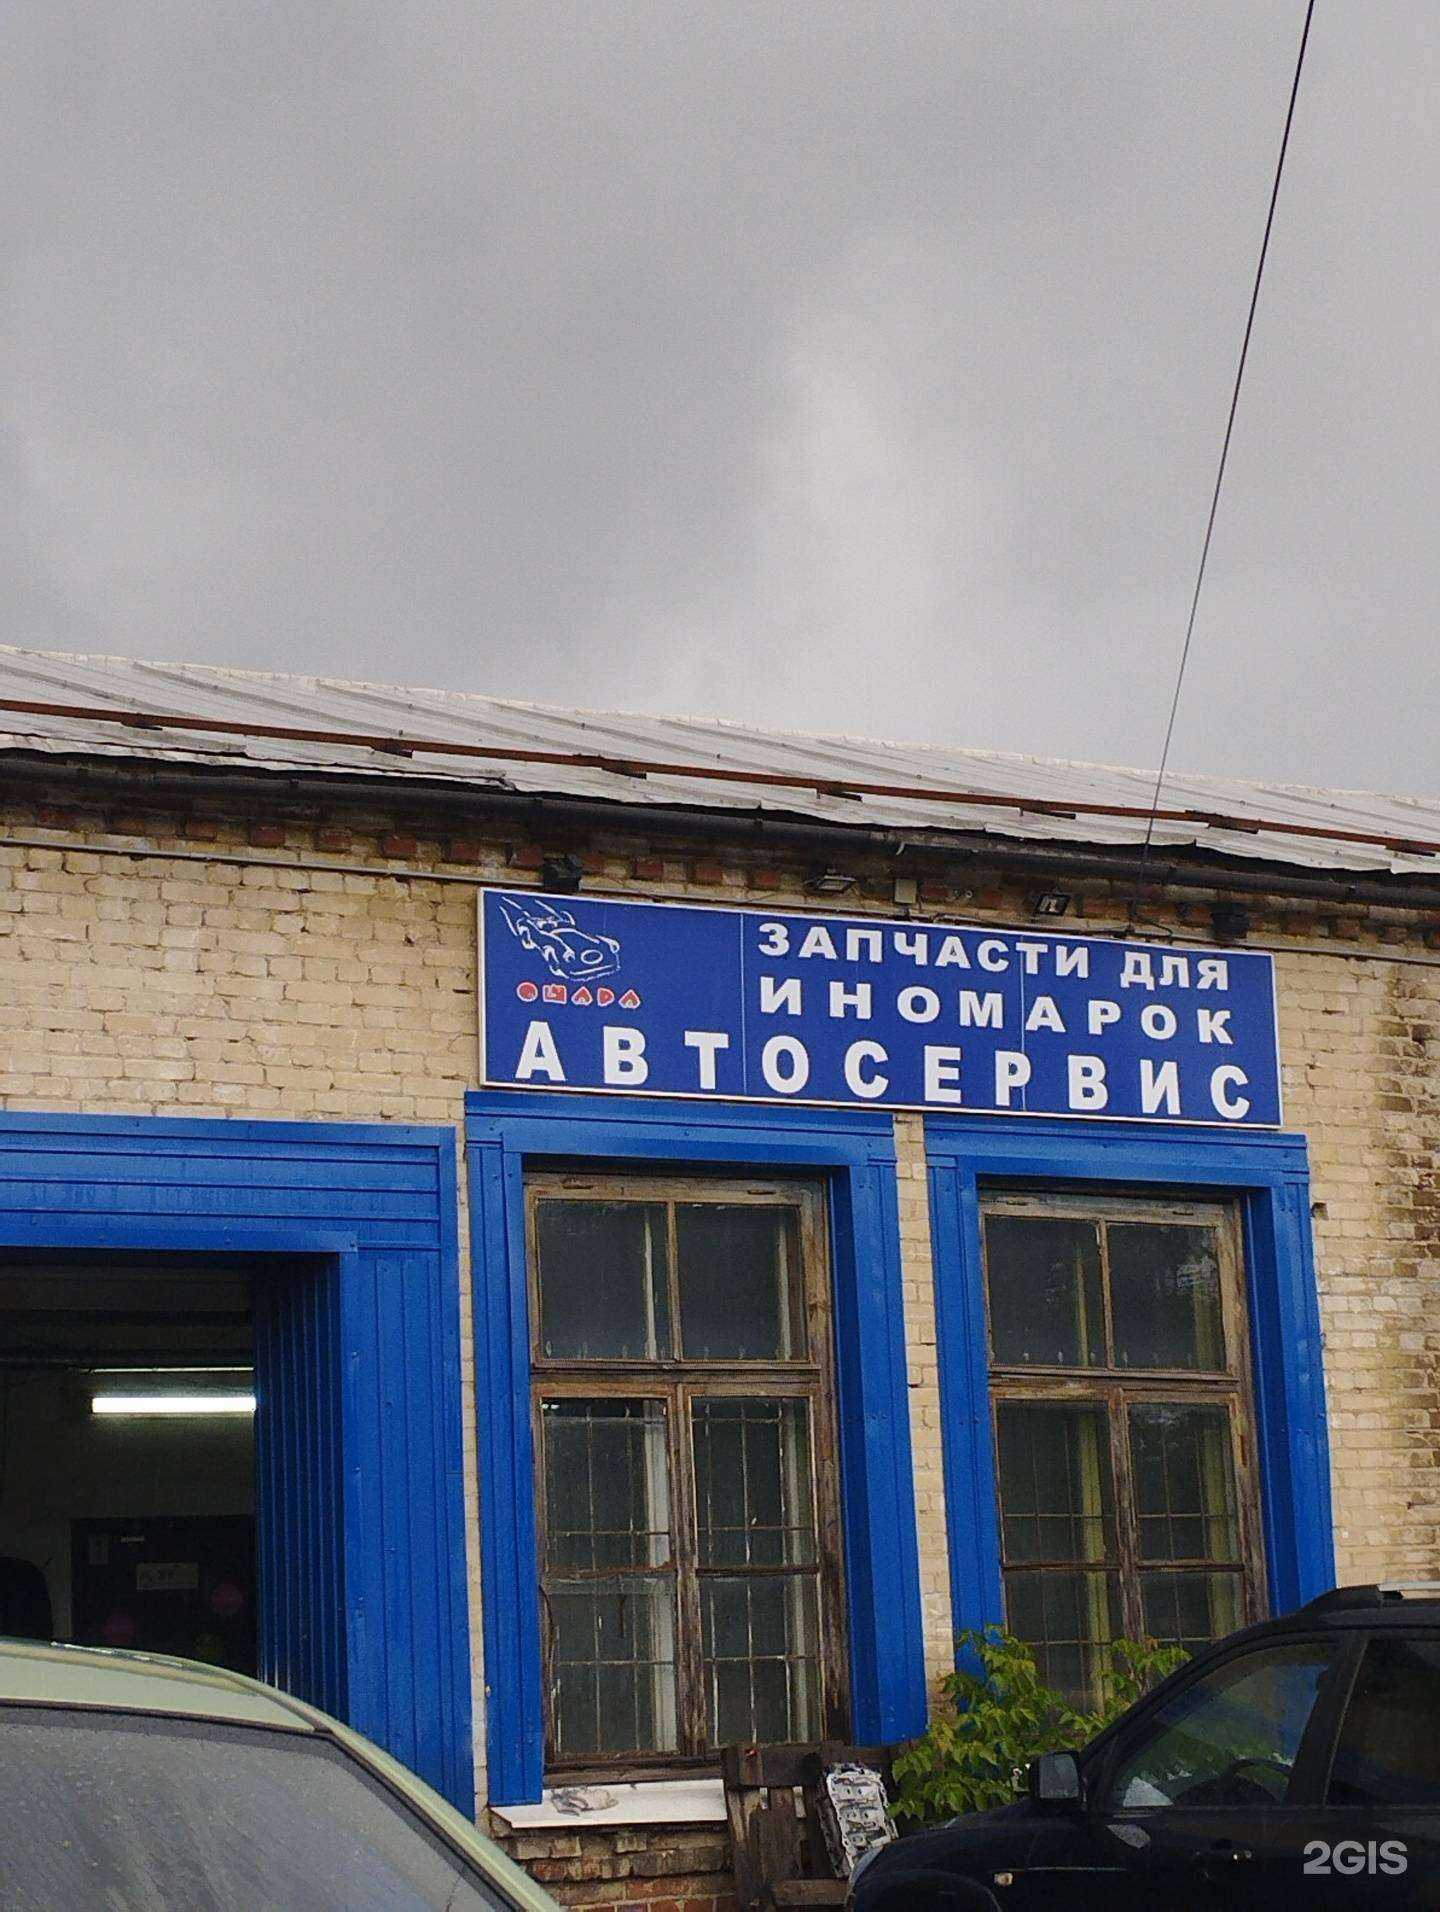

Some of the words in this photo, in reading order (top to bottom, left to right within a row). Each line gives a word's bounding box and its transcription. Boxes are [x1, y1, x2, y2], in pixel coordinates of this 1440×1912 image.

[758, 922, 1090, 979] ЗАПЧАСТИ
[1119, 951, 1229, 991] ДЛЯ
[760, 977, 1234, 1045] ИНОМАРОК
[515, 1020, 1251, 1119] АВТОСЕРВИС
